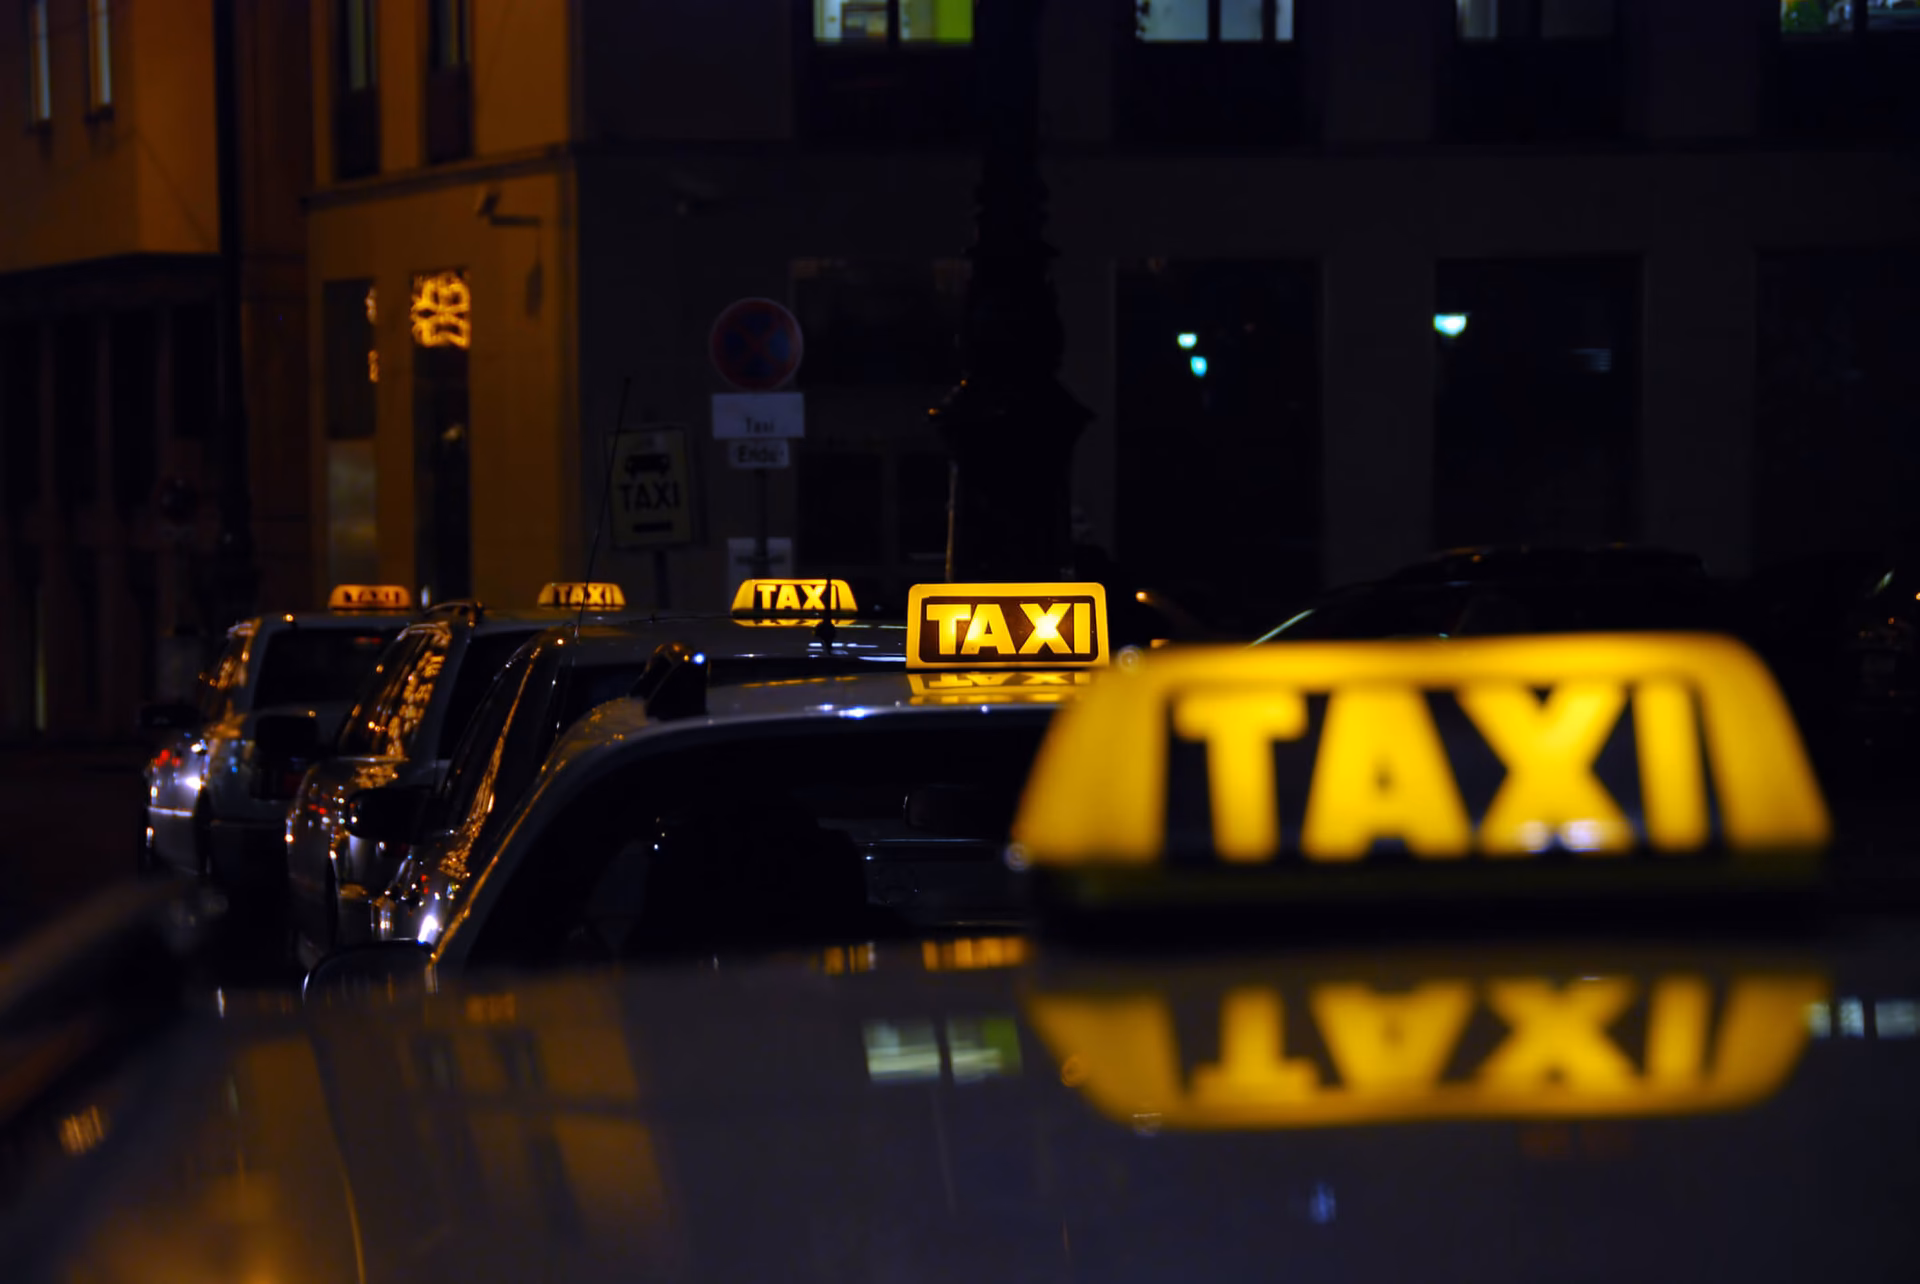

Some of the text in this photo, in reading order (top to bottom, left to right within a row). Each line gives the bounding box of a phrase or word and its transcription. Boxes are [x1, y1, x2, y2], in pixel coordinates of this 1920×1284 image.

[618, 480, 681, 512] TAXI
[555, 585, 611, 604] TAXI
[757, 585, 837, 609] TAXI
[926, 603, 1091, 655] TAXI
[1174, 682, 1710, 862] TAXI
